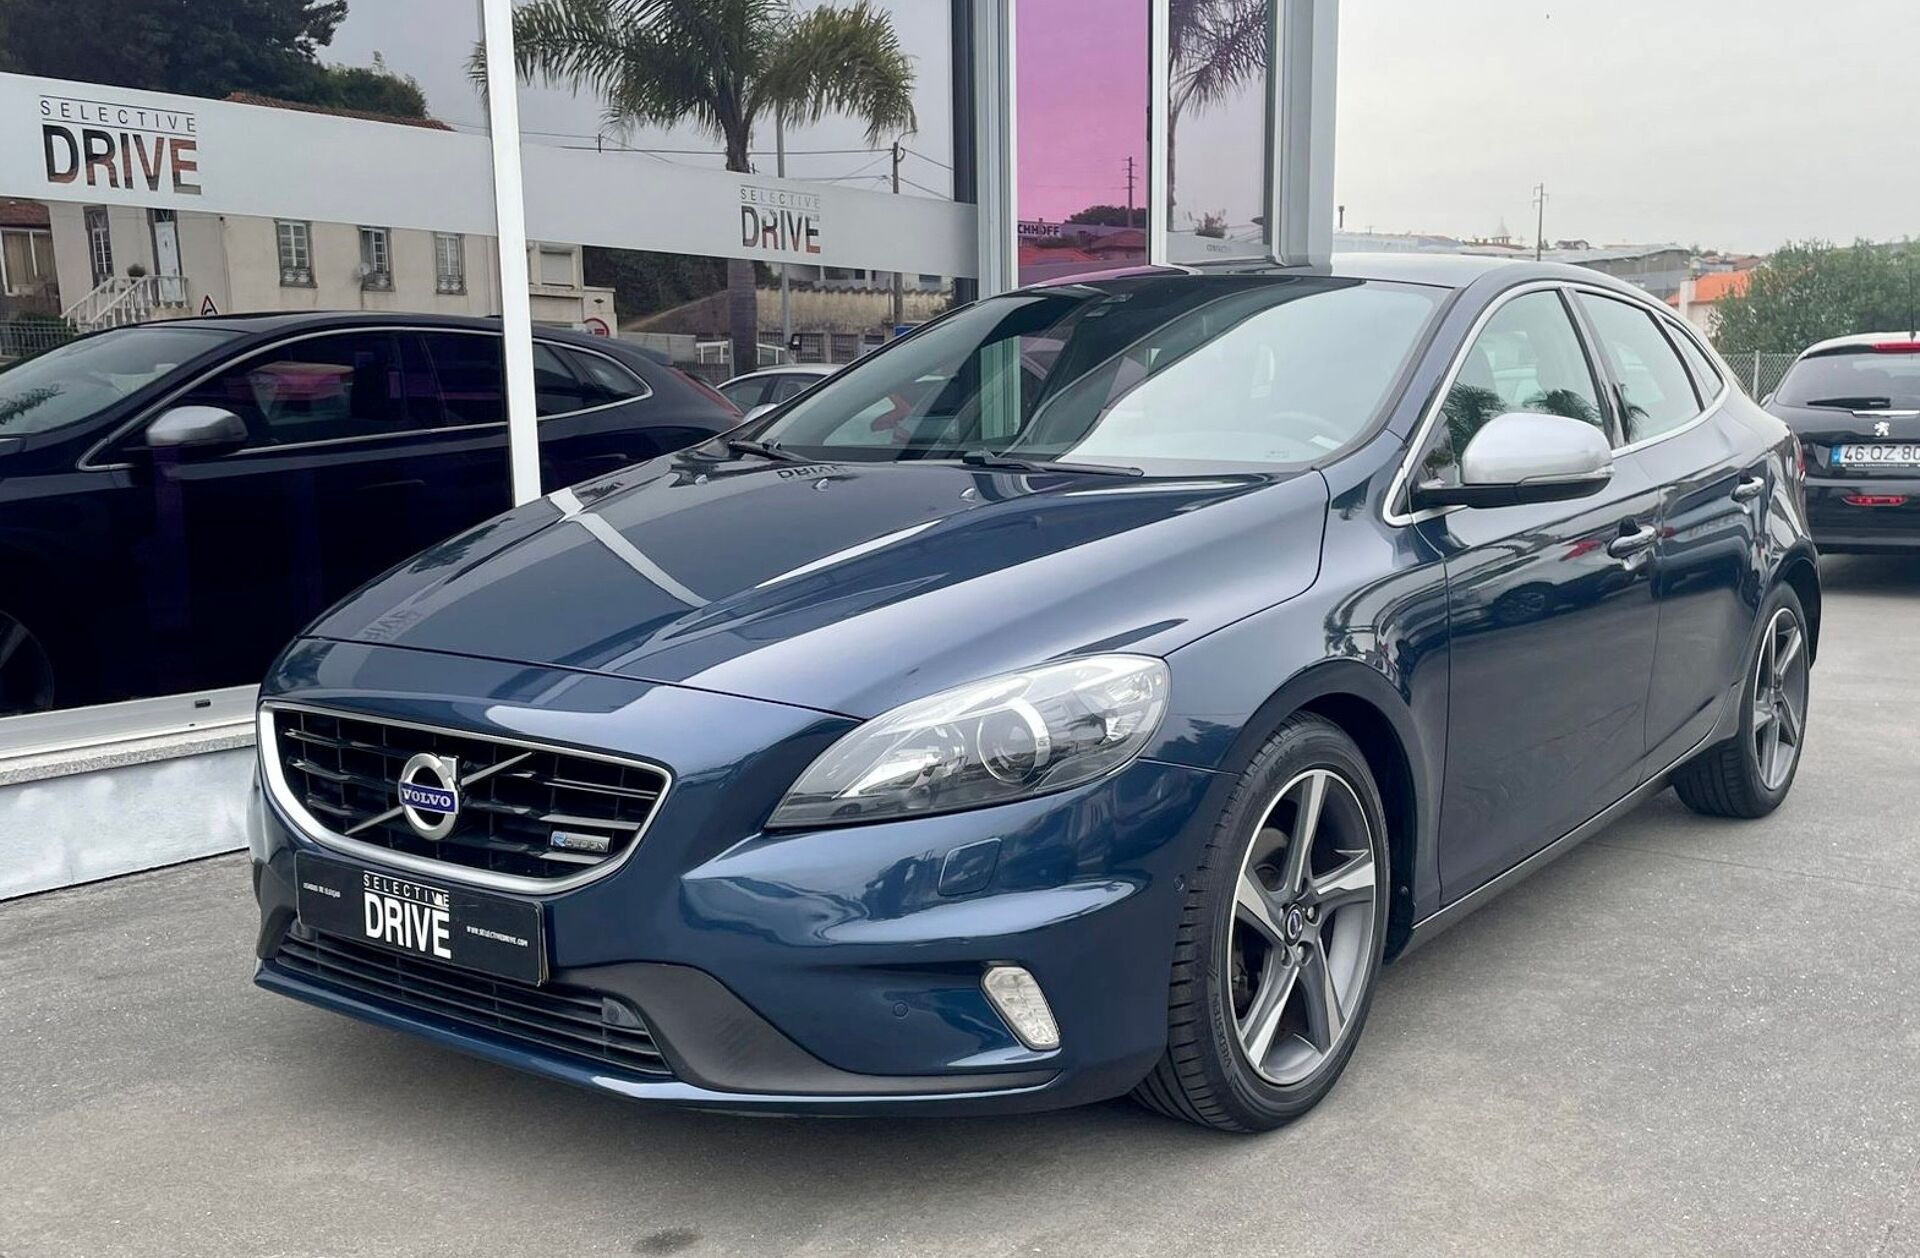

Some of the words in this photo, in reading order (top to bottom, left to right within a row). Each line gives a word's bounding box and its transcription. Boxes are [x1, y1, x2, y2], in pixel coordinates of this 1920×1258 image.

[40, 99, 196, 132] SELECTIVE
[42, 124, 202, 195] DRIVE
[740, 188, 820, 209] SELECTIVE
[741, 205, 821, 254] DRIVE
[401, 788, 451, 807] VOLVO
[363, 873, 450, 908] SELECTIVE
[364, 891, 452, 960] DRIVE
